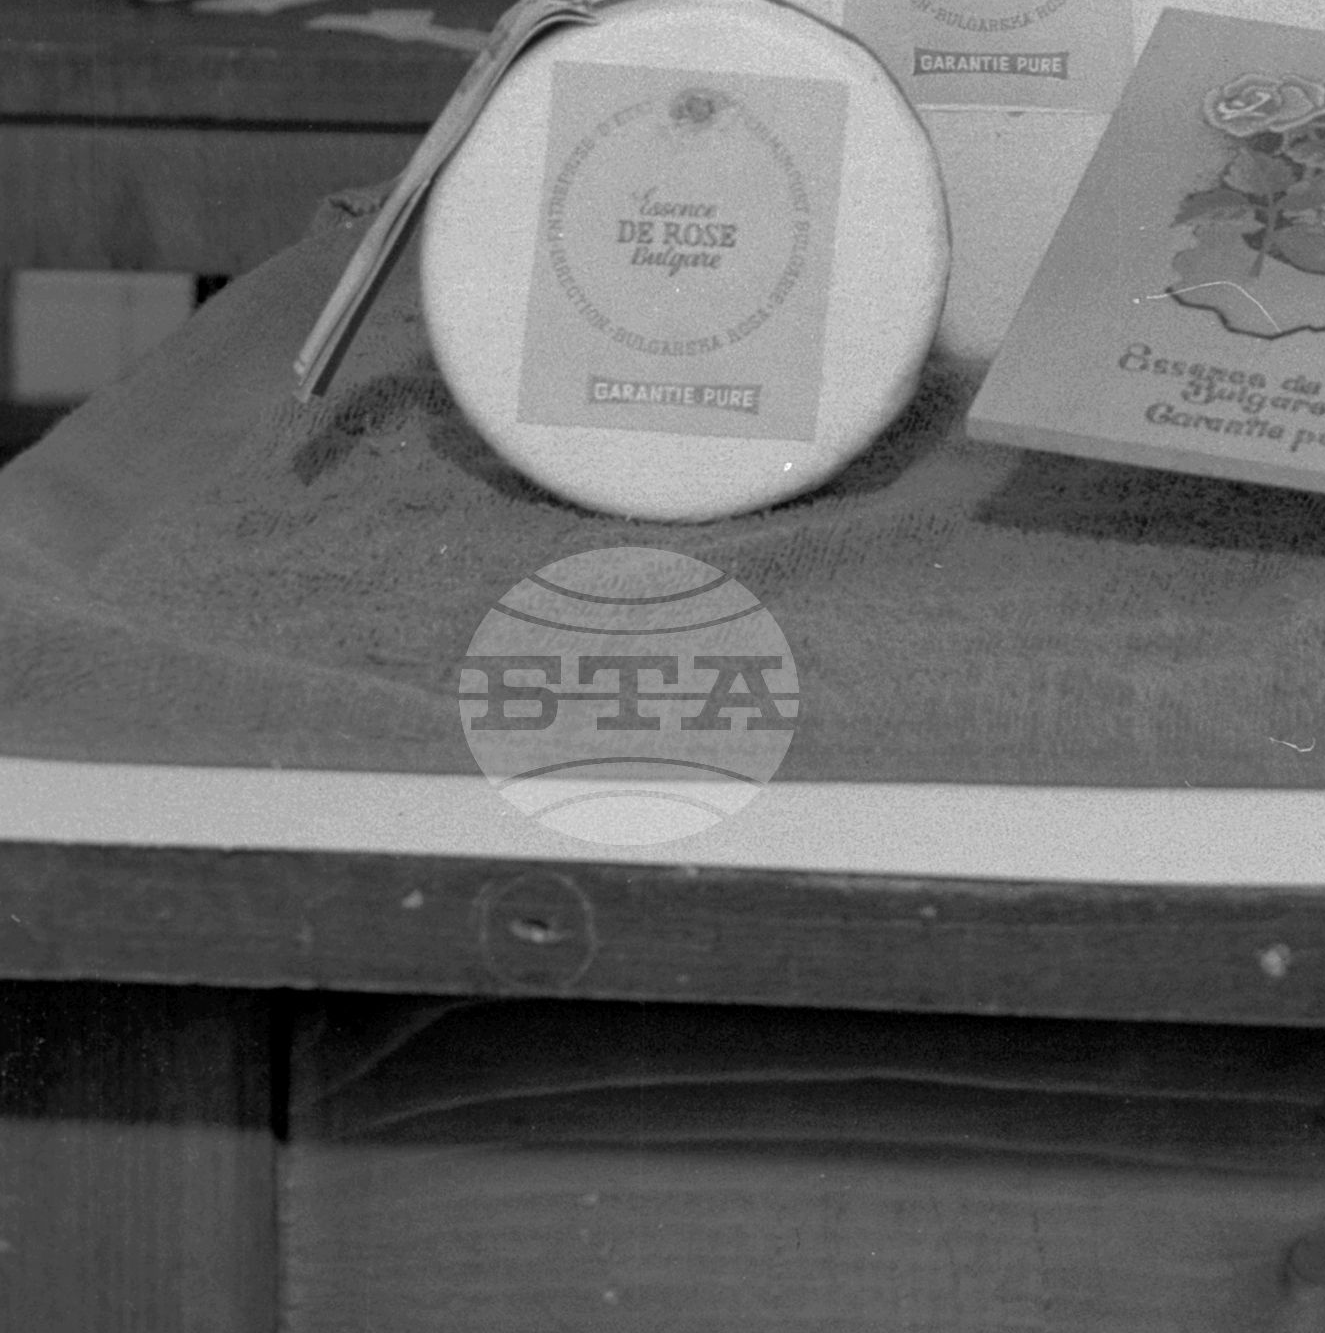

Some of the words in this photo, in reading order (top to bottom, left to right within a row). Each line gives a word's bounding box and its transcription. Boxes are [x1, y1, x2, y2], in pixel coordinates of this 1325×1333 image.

[920, 54, 1010, 72] GARANTIE
[1016, 56, 1063, 73] PURE
[630, 186, 718, 219] Essence
[616, 219, 655, 244] DE
[662, 222, 739, 248] ROSE
[630, 244, 723, 278] Bulgare
[594, 383, 695, 404] GARANTIE
[704, 386, 755, 408] PURE
